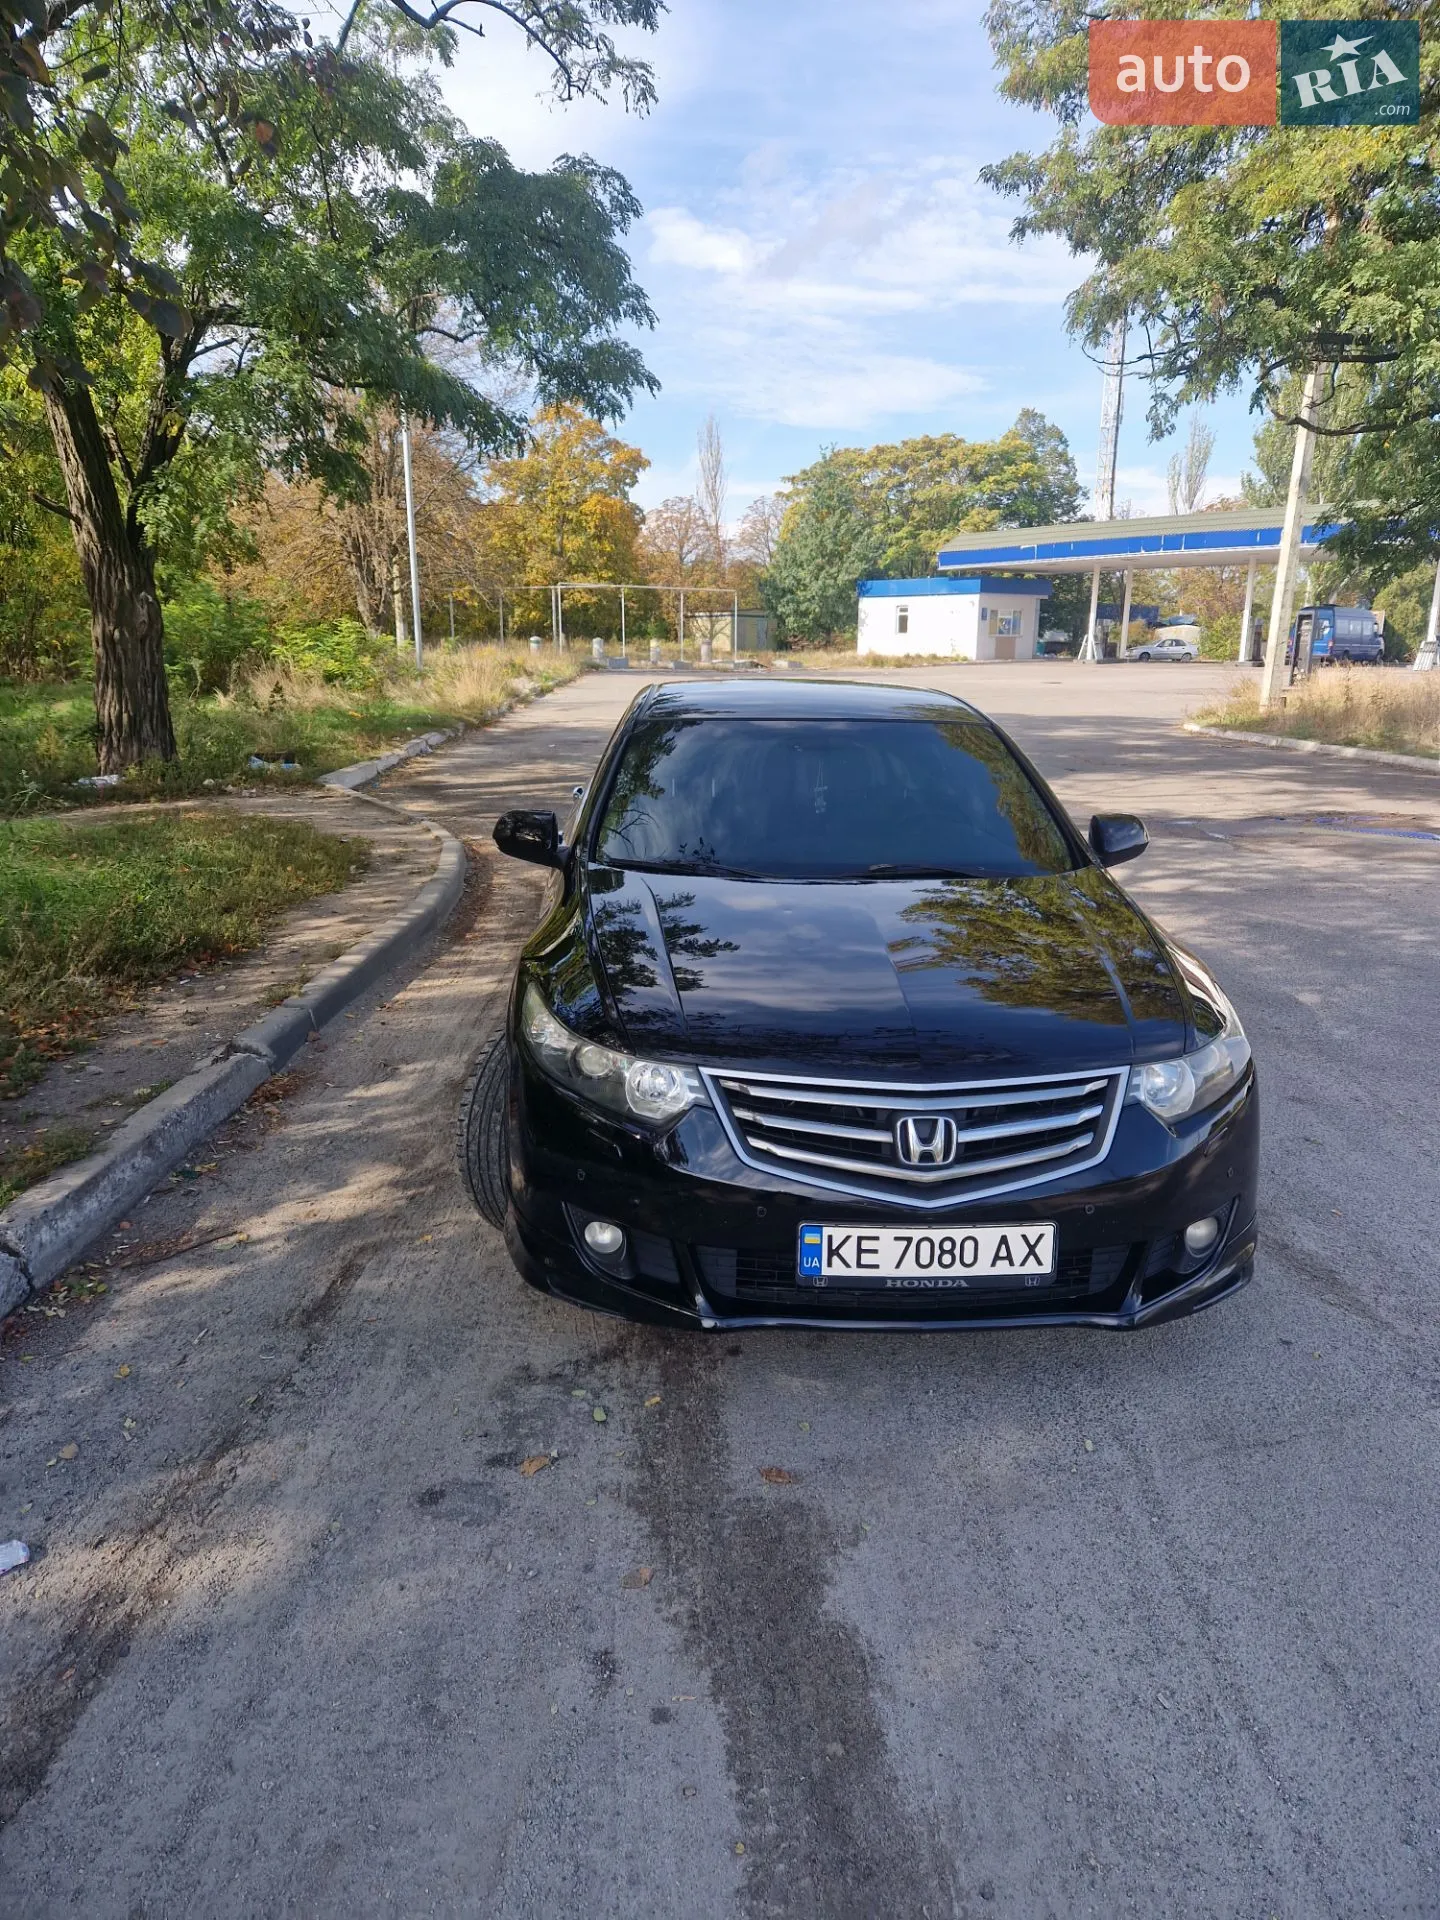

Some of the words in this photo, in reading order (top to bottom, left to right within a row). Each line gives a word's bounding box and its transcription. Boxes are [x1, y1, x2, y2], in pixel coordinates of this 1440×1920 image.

[827, 1234, 880, 1269] KE
[893, 1236, 979, 1269] 7080
[990, 1233, 1046, 1268] AX
[804, 1257, 819, 1268] UA
[885, 1279, 969, 1288] HONDA
